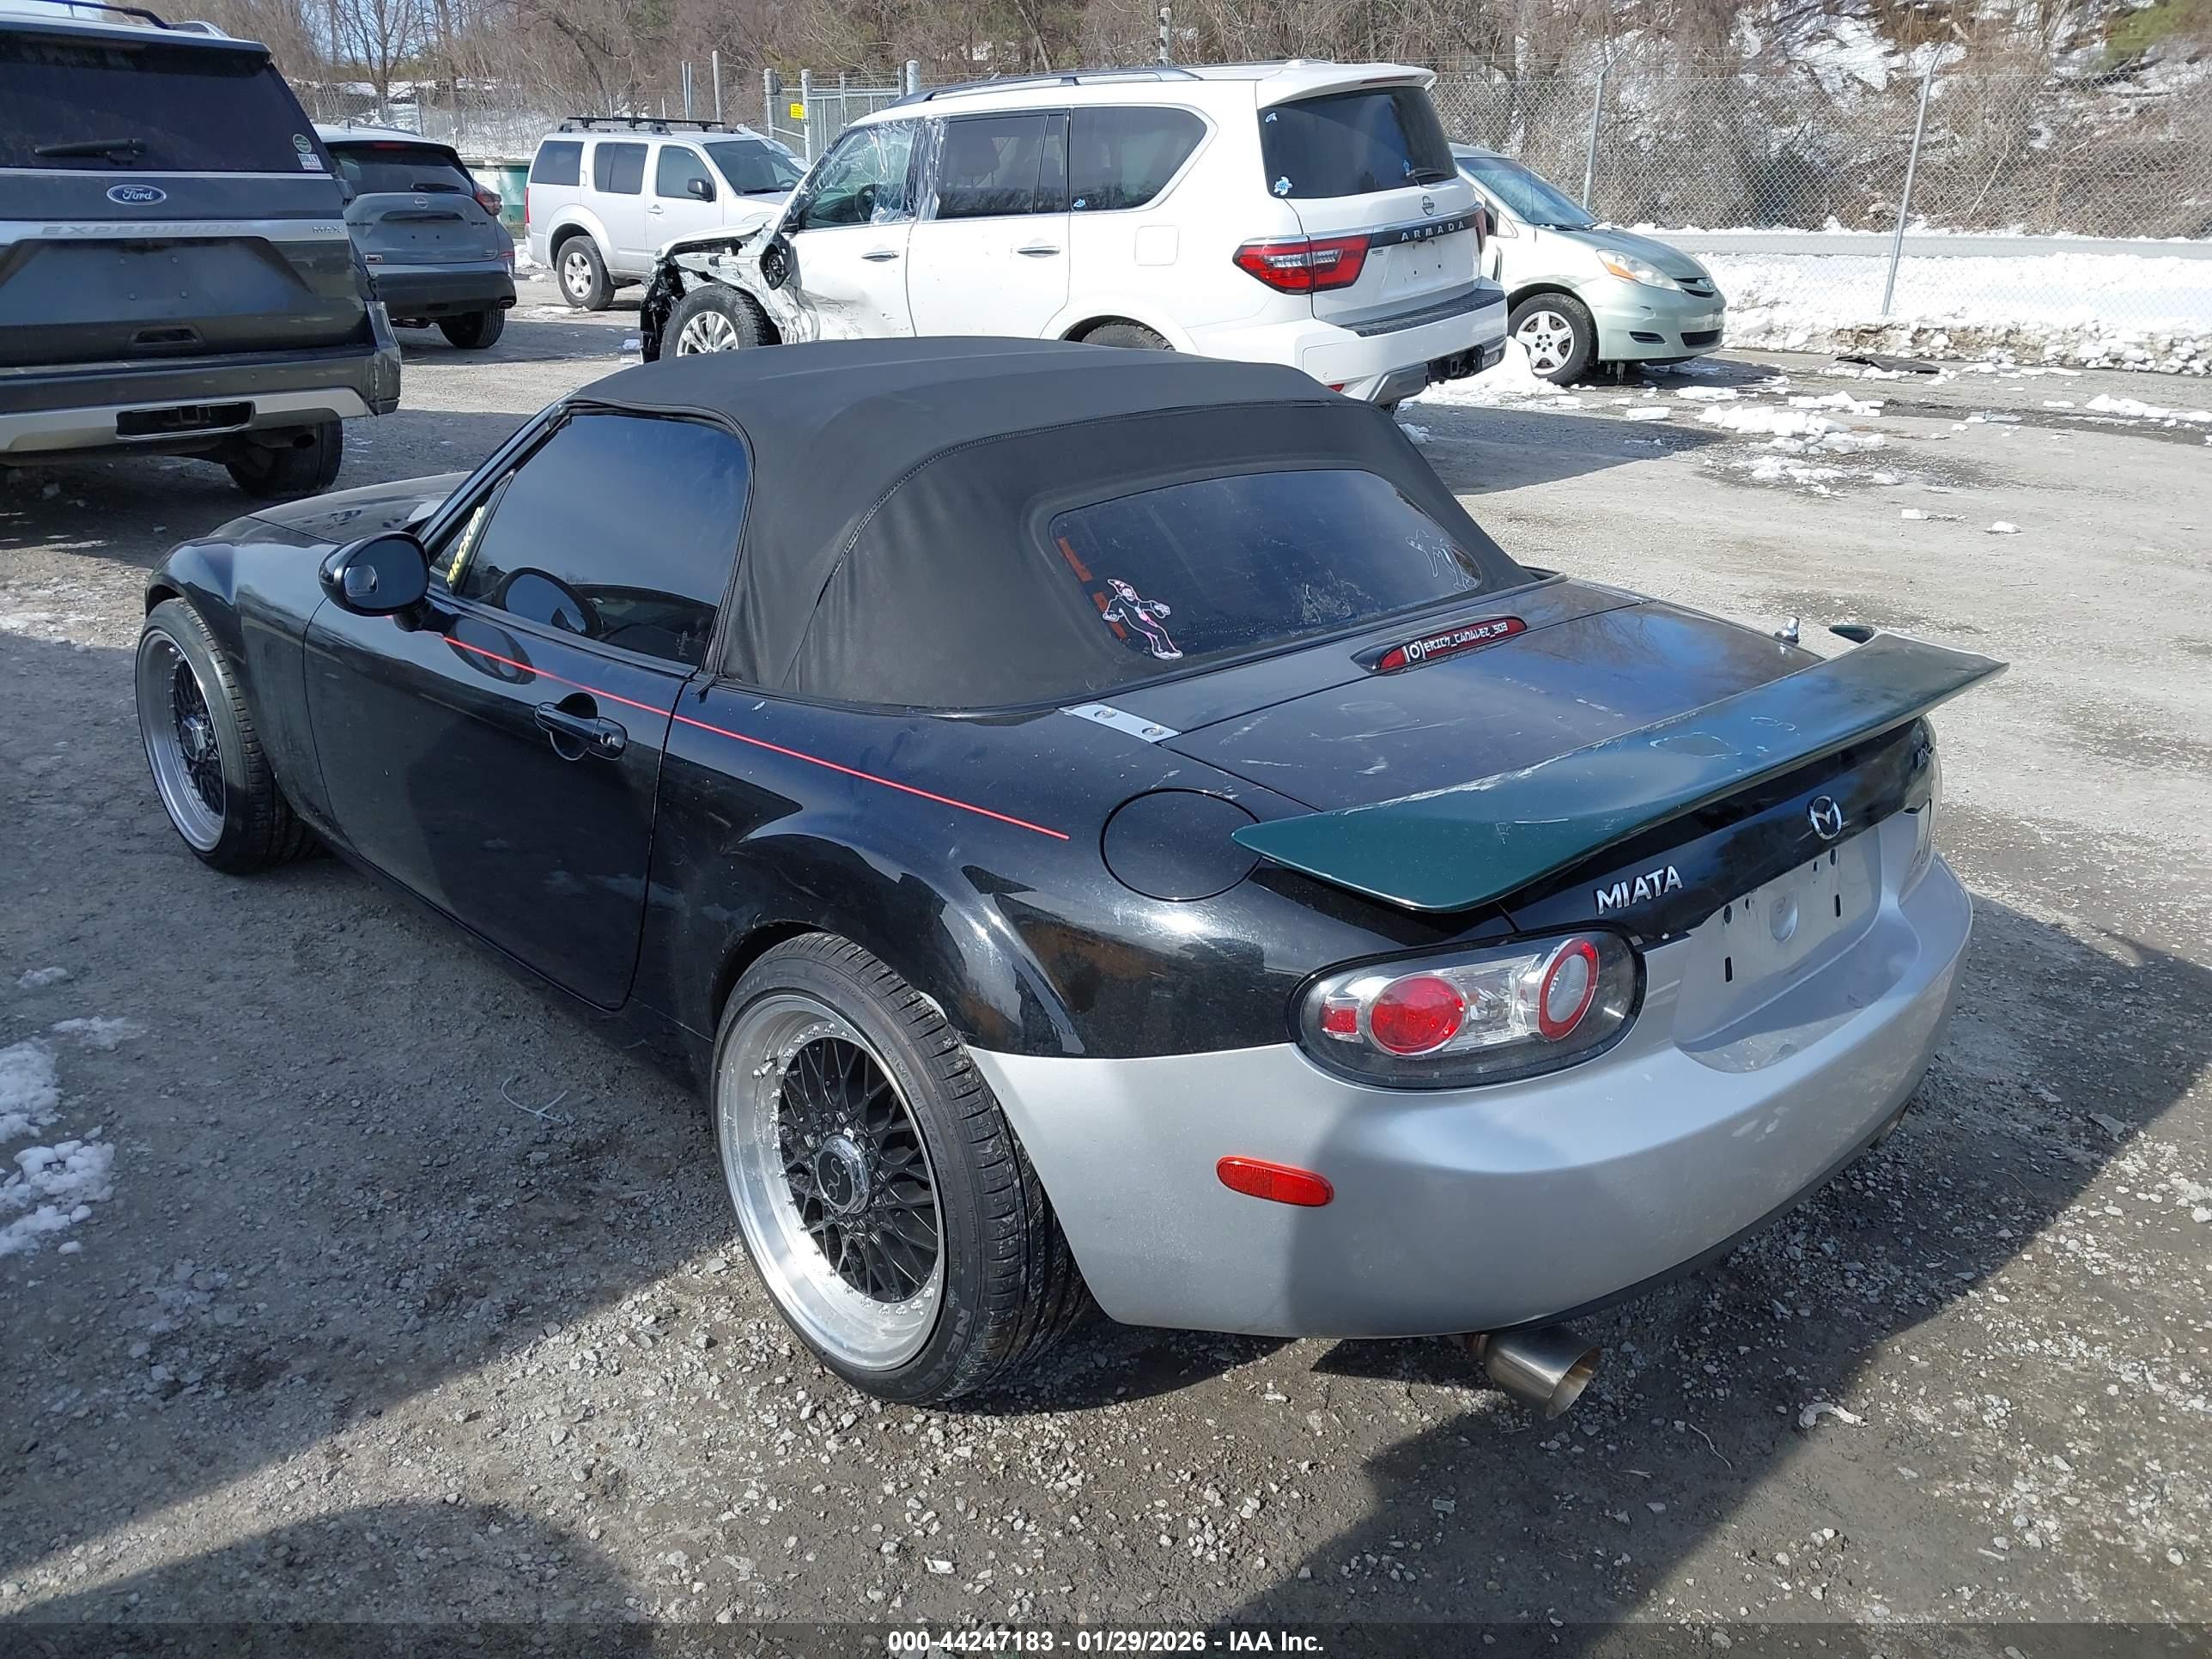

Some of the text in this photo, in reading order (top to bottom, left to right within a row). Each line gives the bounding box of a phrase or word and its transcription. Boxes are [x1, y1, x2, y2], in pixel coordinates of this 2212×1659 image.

[123, 188, 152, 199] Ford
[41, 225, 242, 235] EXPEDITION
[1401, 221, 1465, 241] ARMADA
[1596, 865, 1683, 915] MIATA
[906, 1307, 971, 1391] NEXE
